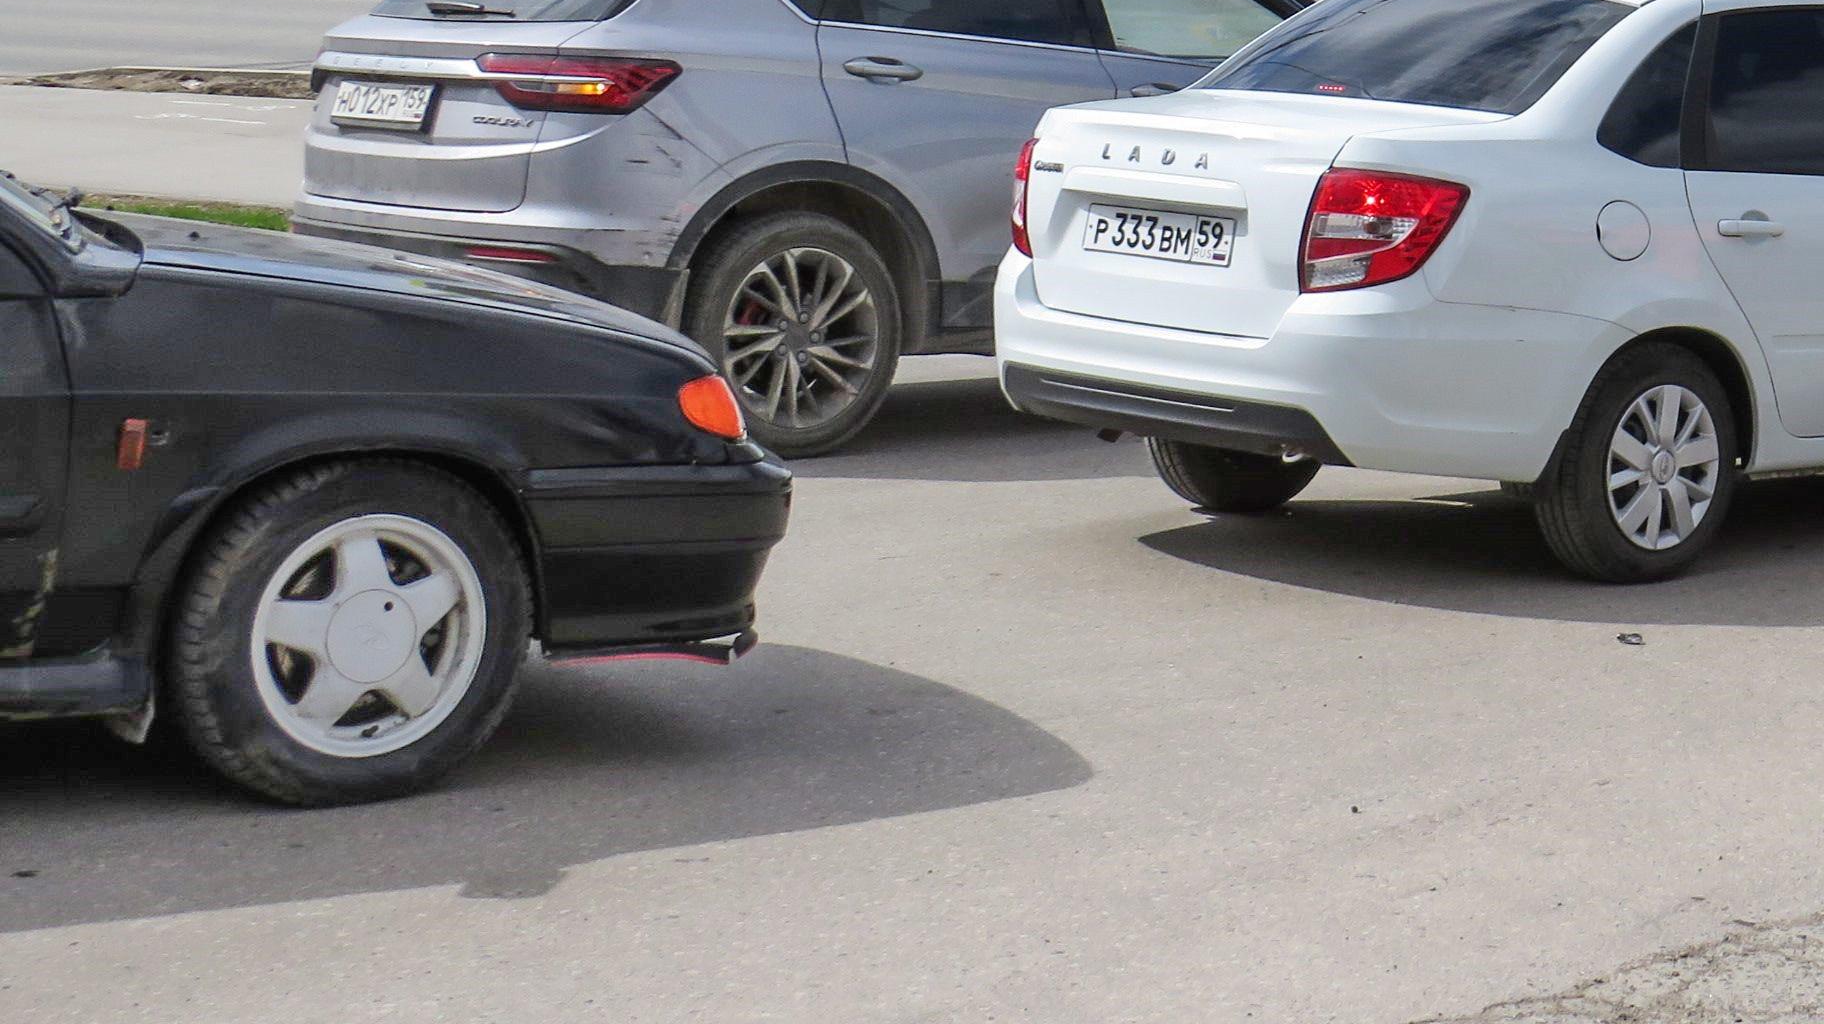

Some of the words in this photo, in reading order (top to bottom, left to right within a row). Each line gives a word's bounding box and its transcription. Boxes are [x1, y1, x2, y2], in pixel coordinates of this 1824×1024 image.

[473, 115, 534, 127] COOLRAY
[1102, 143, 1208, 170] LADA
[1094, 213, 1192, 255] Р333ВМ
[1197, 220, 1224, 249] 59
[1193, 247, 1212, 259] RUS
